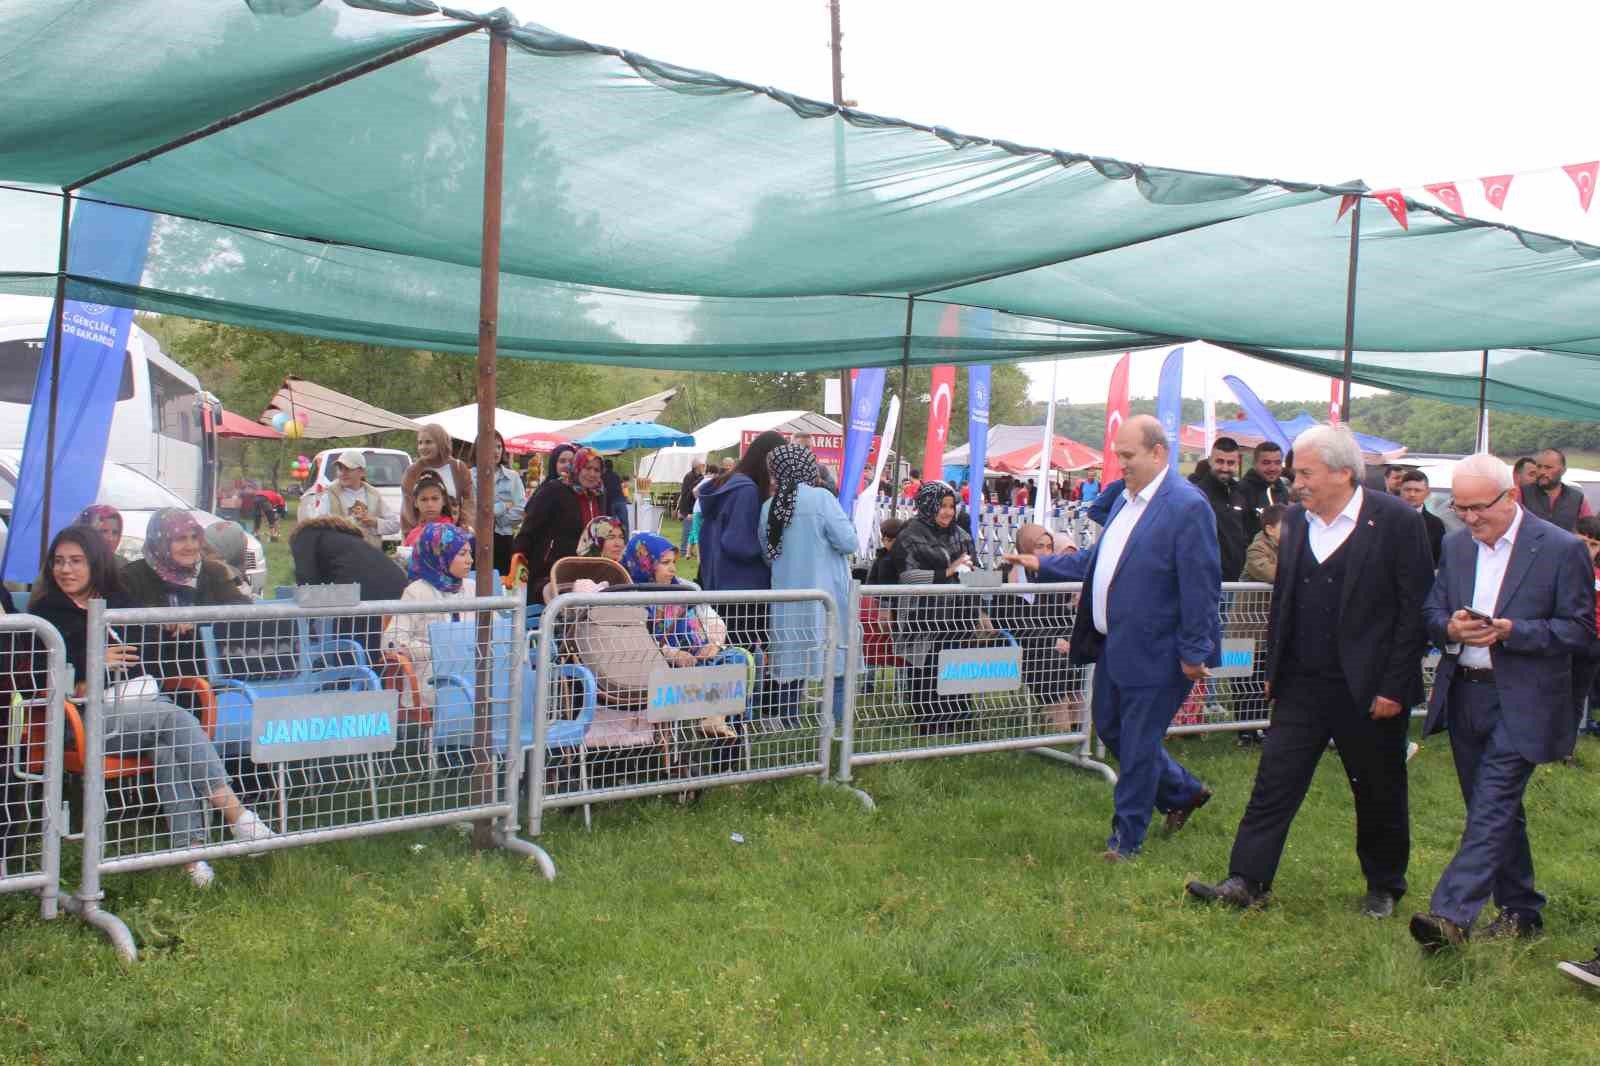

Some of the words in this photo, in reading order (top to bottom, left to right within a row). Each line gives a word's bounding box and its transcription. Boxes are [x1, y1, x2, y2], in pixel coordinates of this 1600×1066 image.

[942, 656, 1018, 681] JANDARMA
[1221, 649, 1252, 667] ARMA
[257, 711, 392, 746] JANDARMA
